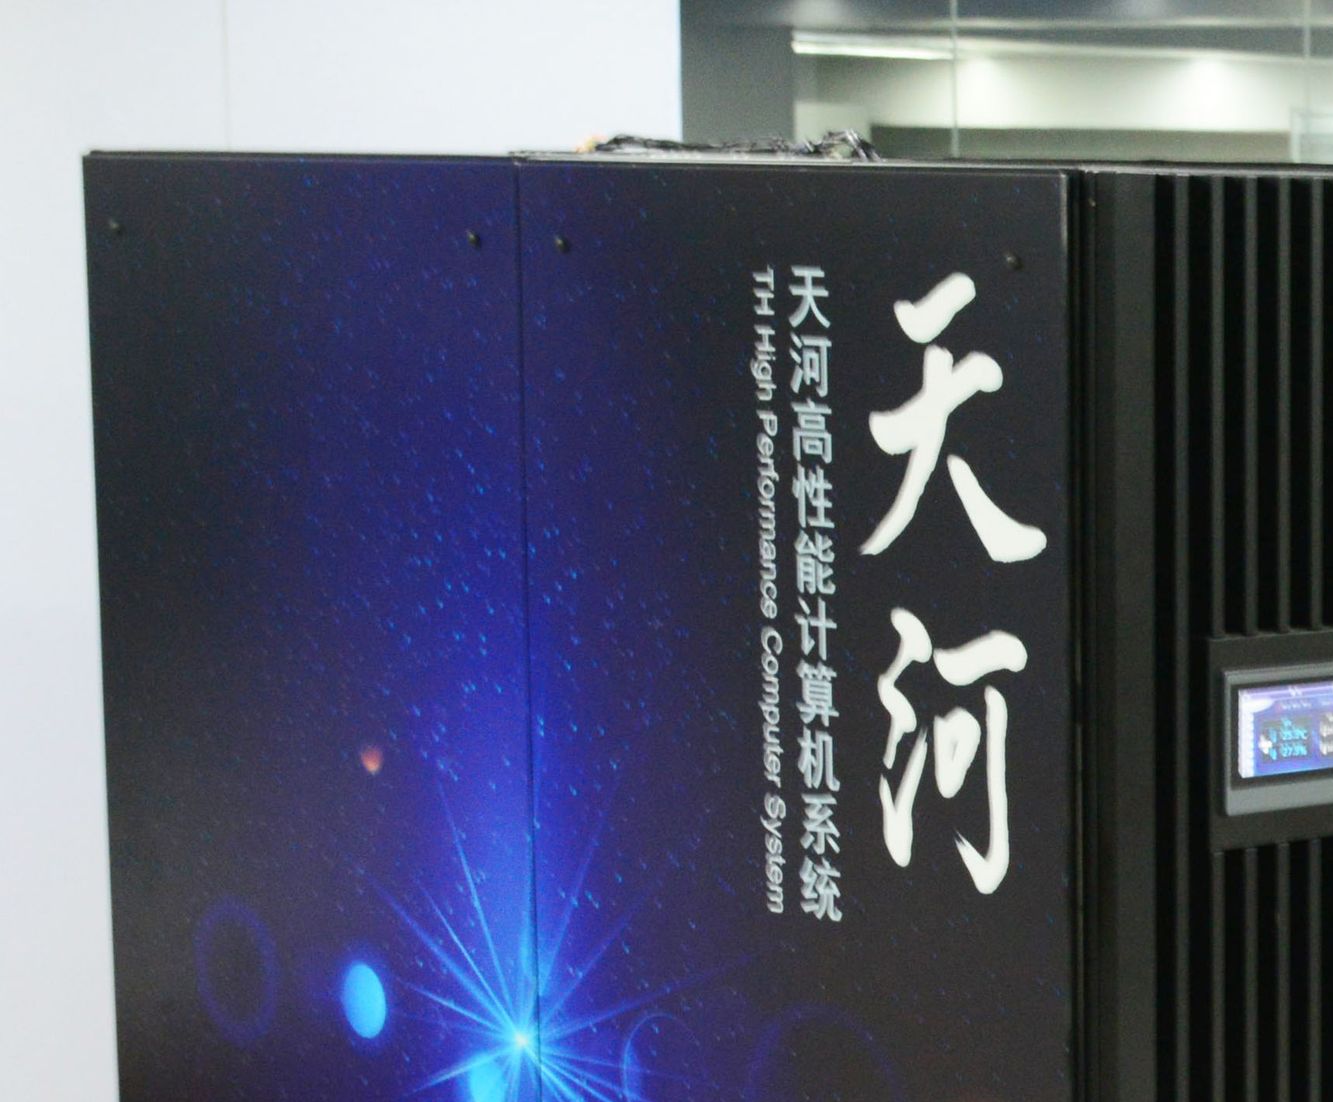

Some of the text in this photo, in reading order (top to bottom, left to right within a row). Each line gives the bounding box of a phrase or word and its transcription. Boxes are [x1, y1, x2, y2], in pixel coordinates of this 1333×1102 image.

[751, 264, 786, 914] TH High Performance Computer System
[788, 264, 842, 922] 天河高性能计算机系统
[859, 271, 1048, 895] 天河
